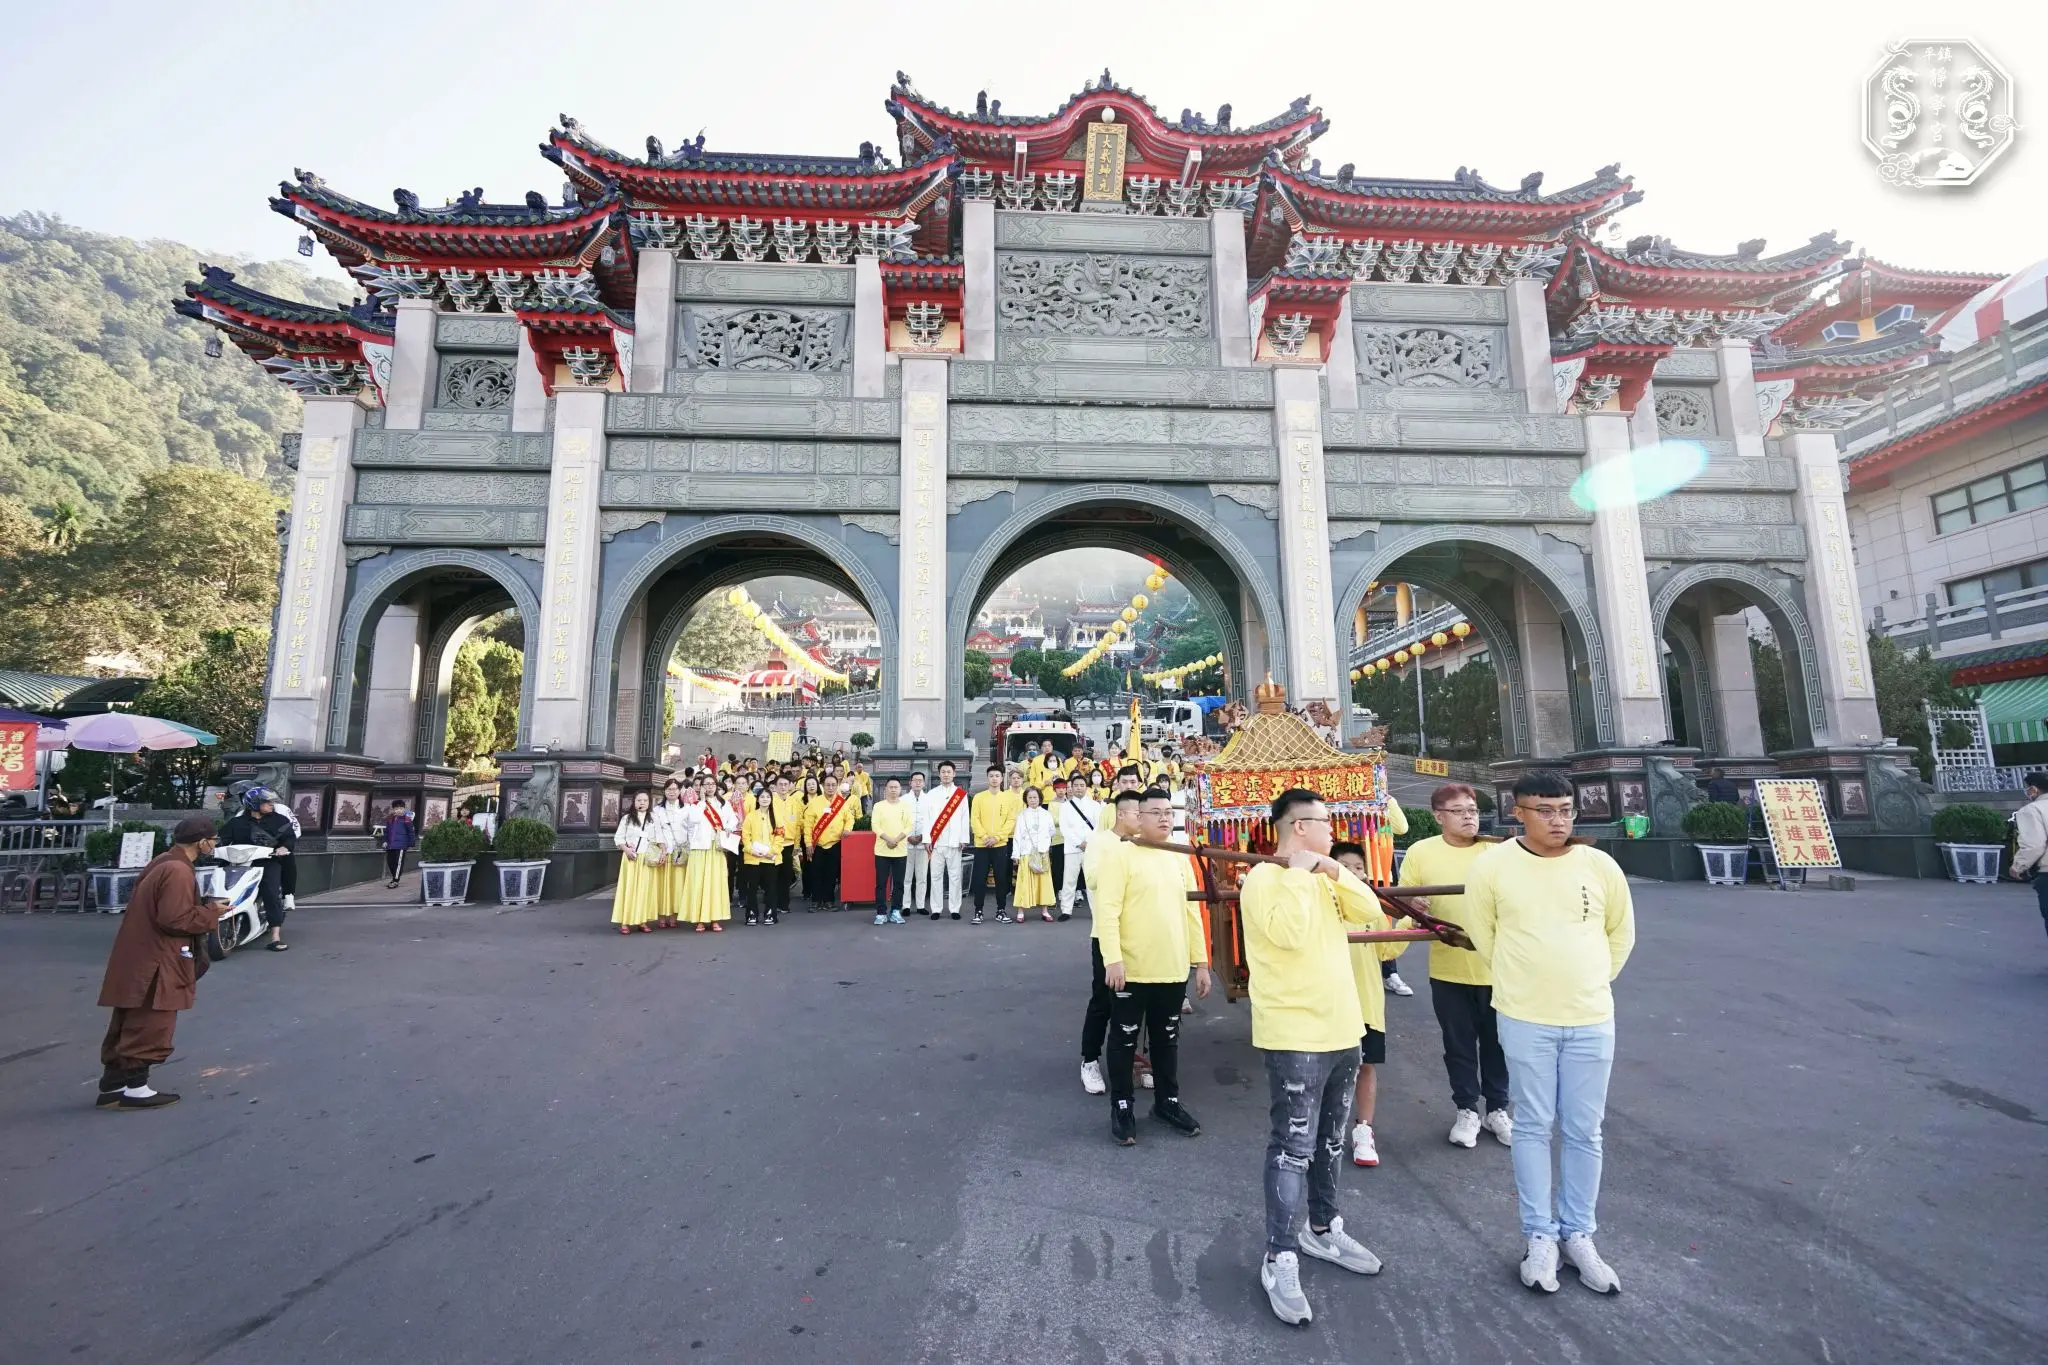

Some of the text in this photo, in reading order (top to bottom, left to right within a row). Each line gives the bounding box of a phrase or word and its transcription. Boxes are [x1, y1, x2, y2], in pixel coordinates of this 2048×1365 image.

[1775, 786, 1809, 860] 禁止進入
[1796, 787, 1831, 860] 大型車輛
